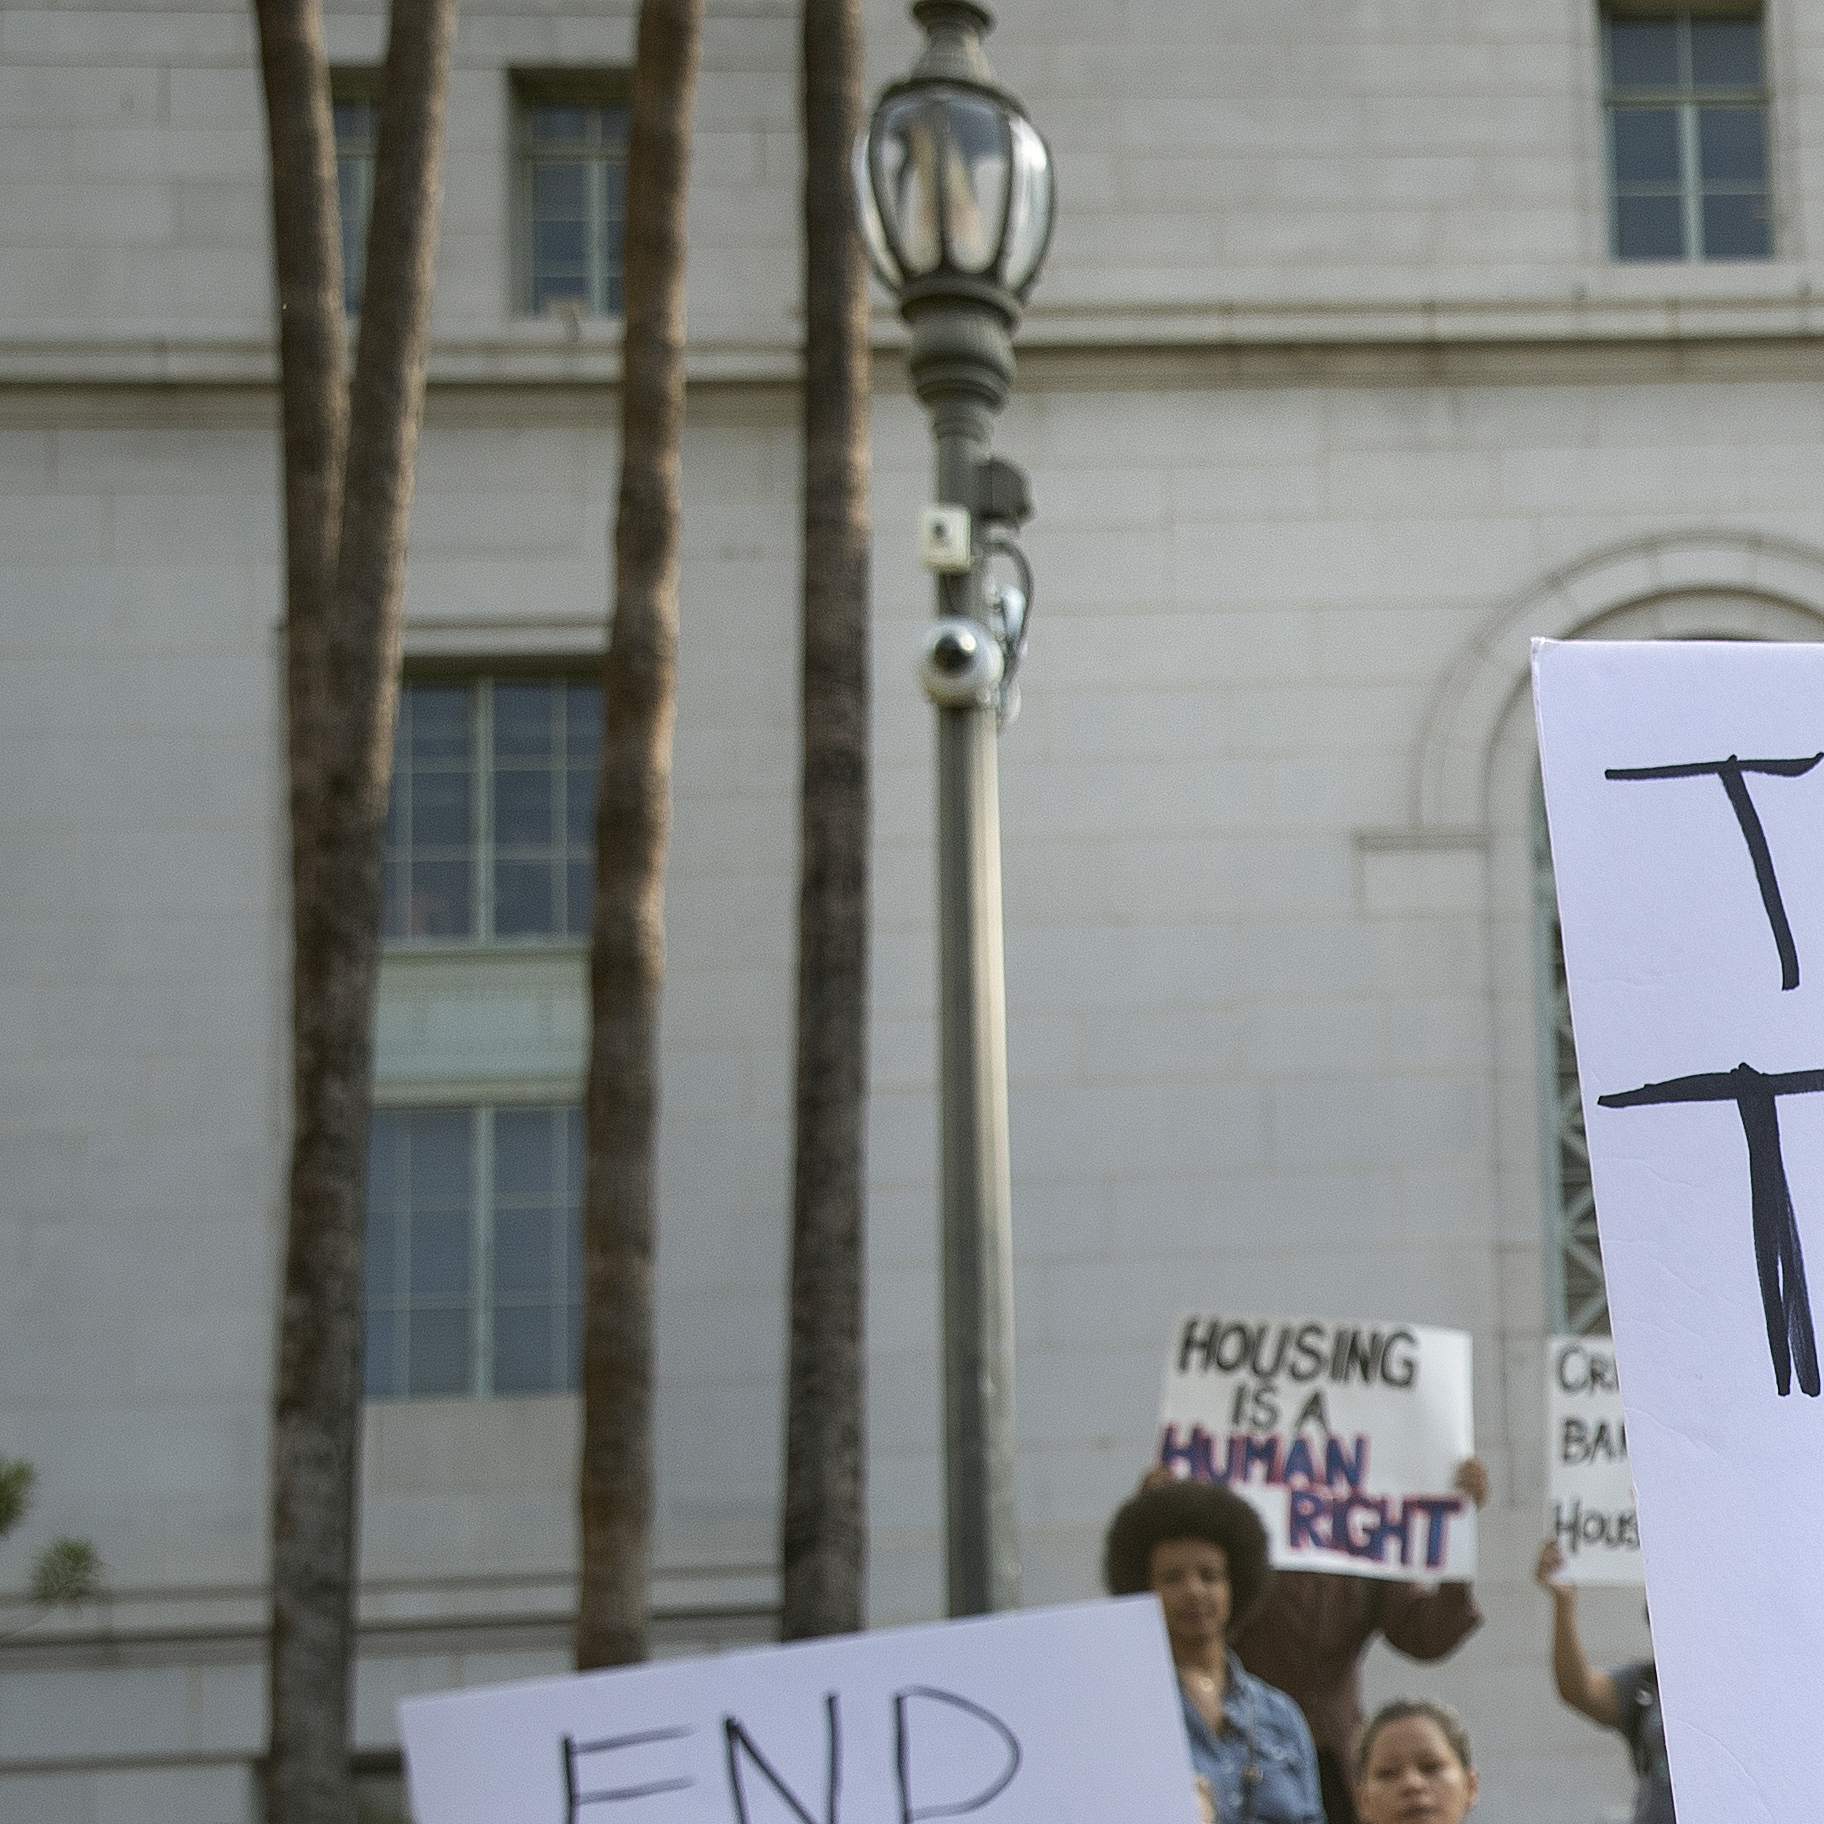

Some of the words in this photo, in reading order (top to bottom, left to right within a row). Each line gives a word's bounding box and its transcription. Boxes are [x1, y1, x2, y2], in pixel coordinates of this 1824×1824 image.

[1178, 1315, 1417, 1389] HOUSING
[1558, 1345, 1620, 1393] CR
[1231, 1380, 1279, 1431] IS
[1292, 1387, 1330, 1438] A
[1563, 1419, 1627, 1464] BA
[1160, 1420, 1371, 1496] HUMAN
[1288, 1490, 1465, 1569] RIGHT
